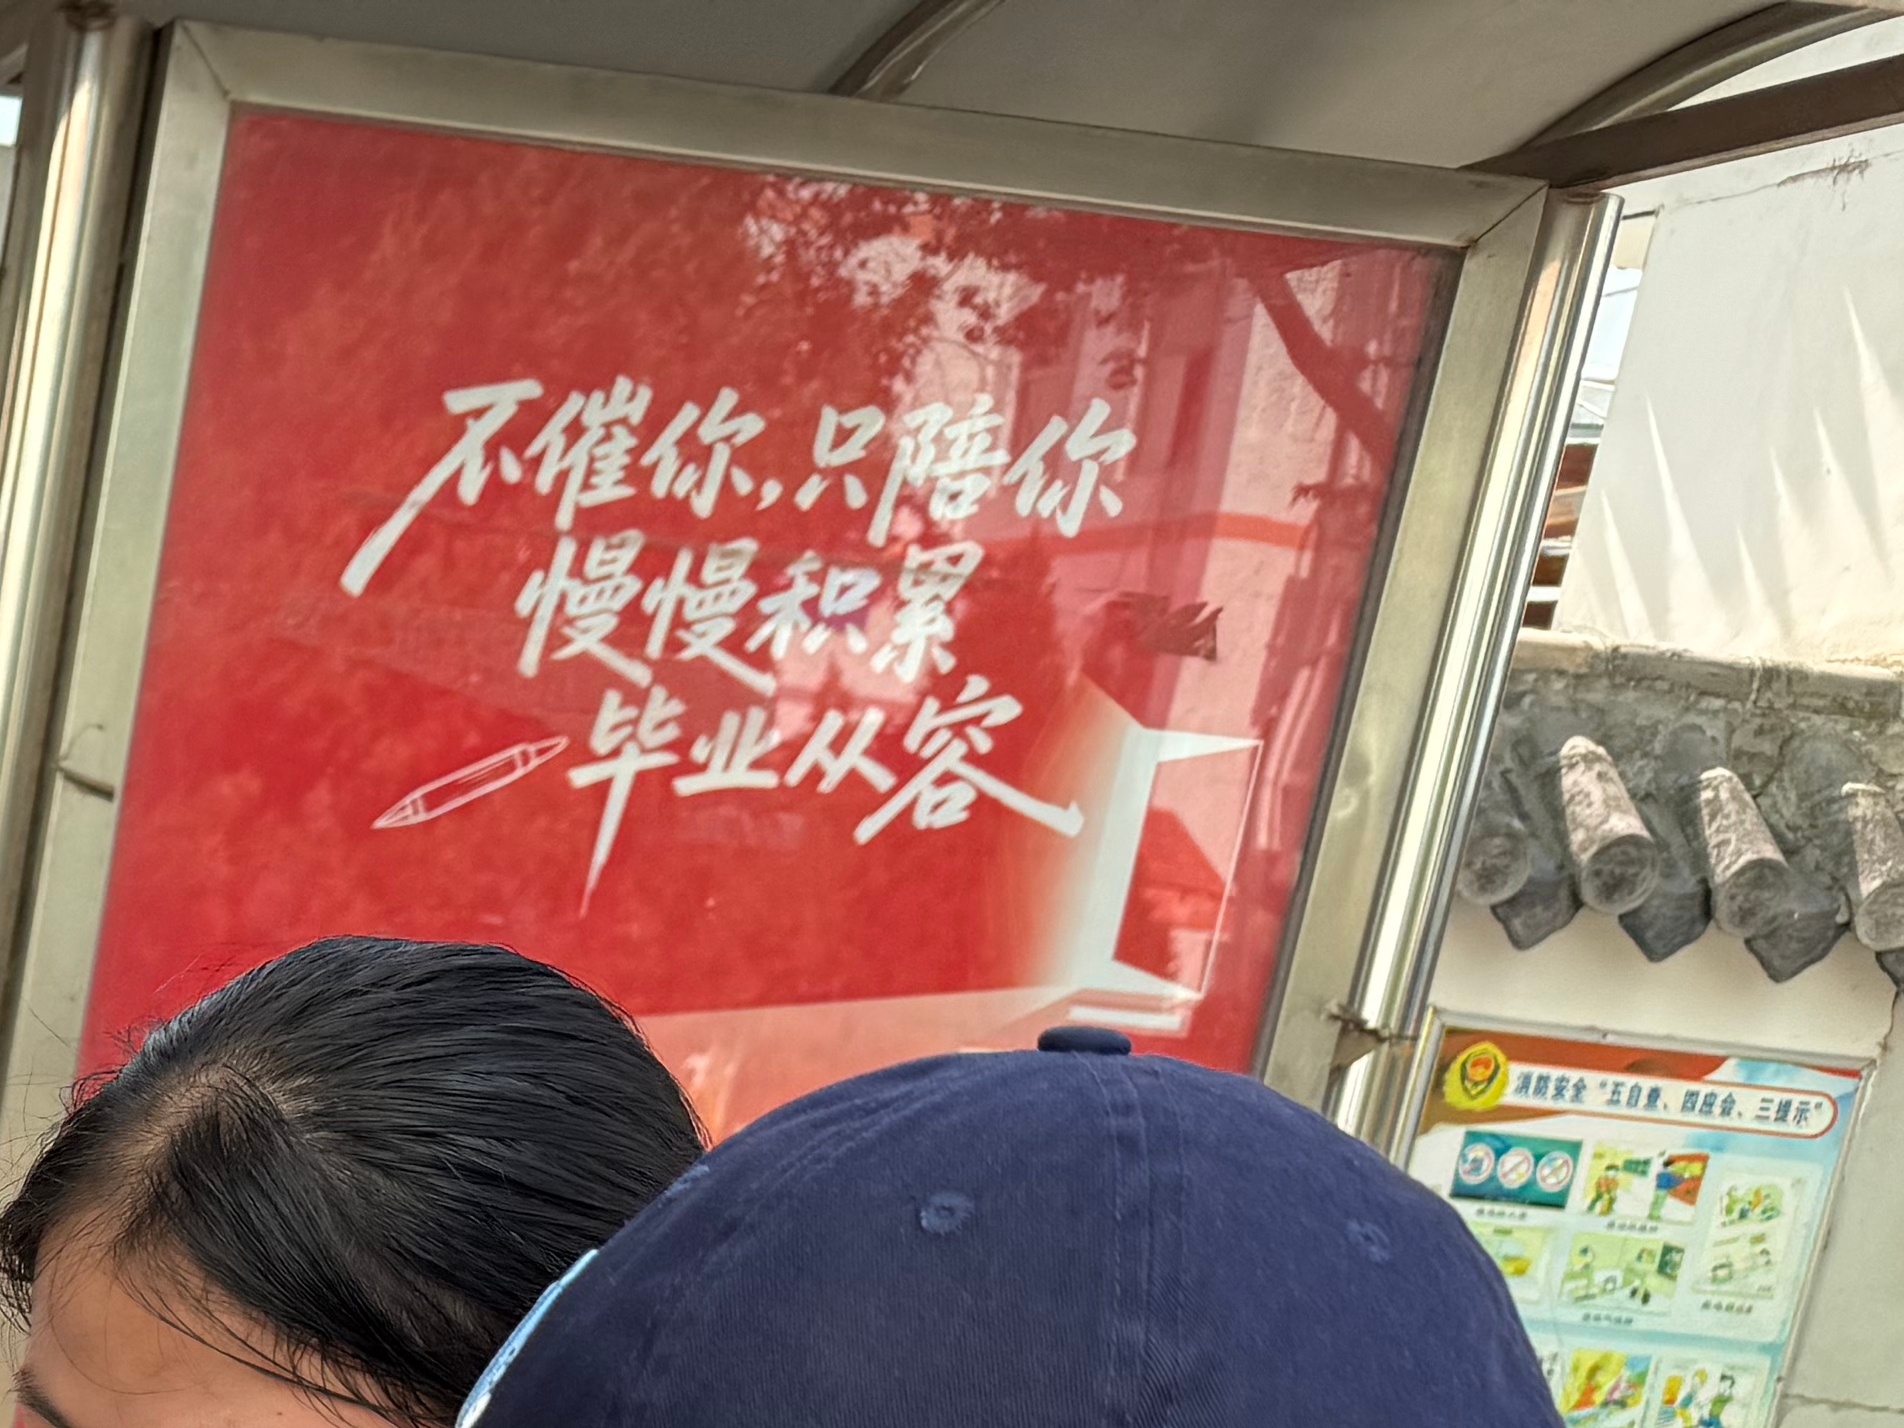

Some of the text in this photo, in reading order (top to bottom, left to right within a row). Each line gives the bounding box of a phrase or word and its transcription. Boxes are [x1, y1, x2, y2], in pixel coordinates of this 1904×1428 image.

[515, 530, 984, 698] 慢慢积累
[568, 677, 1086, 917] 毕业从容
